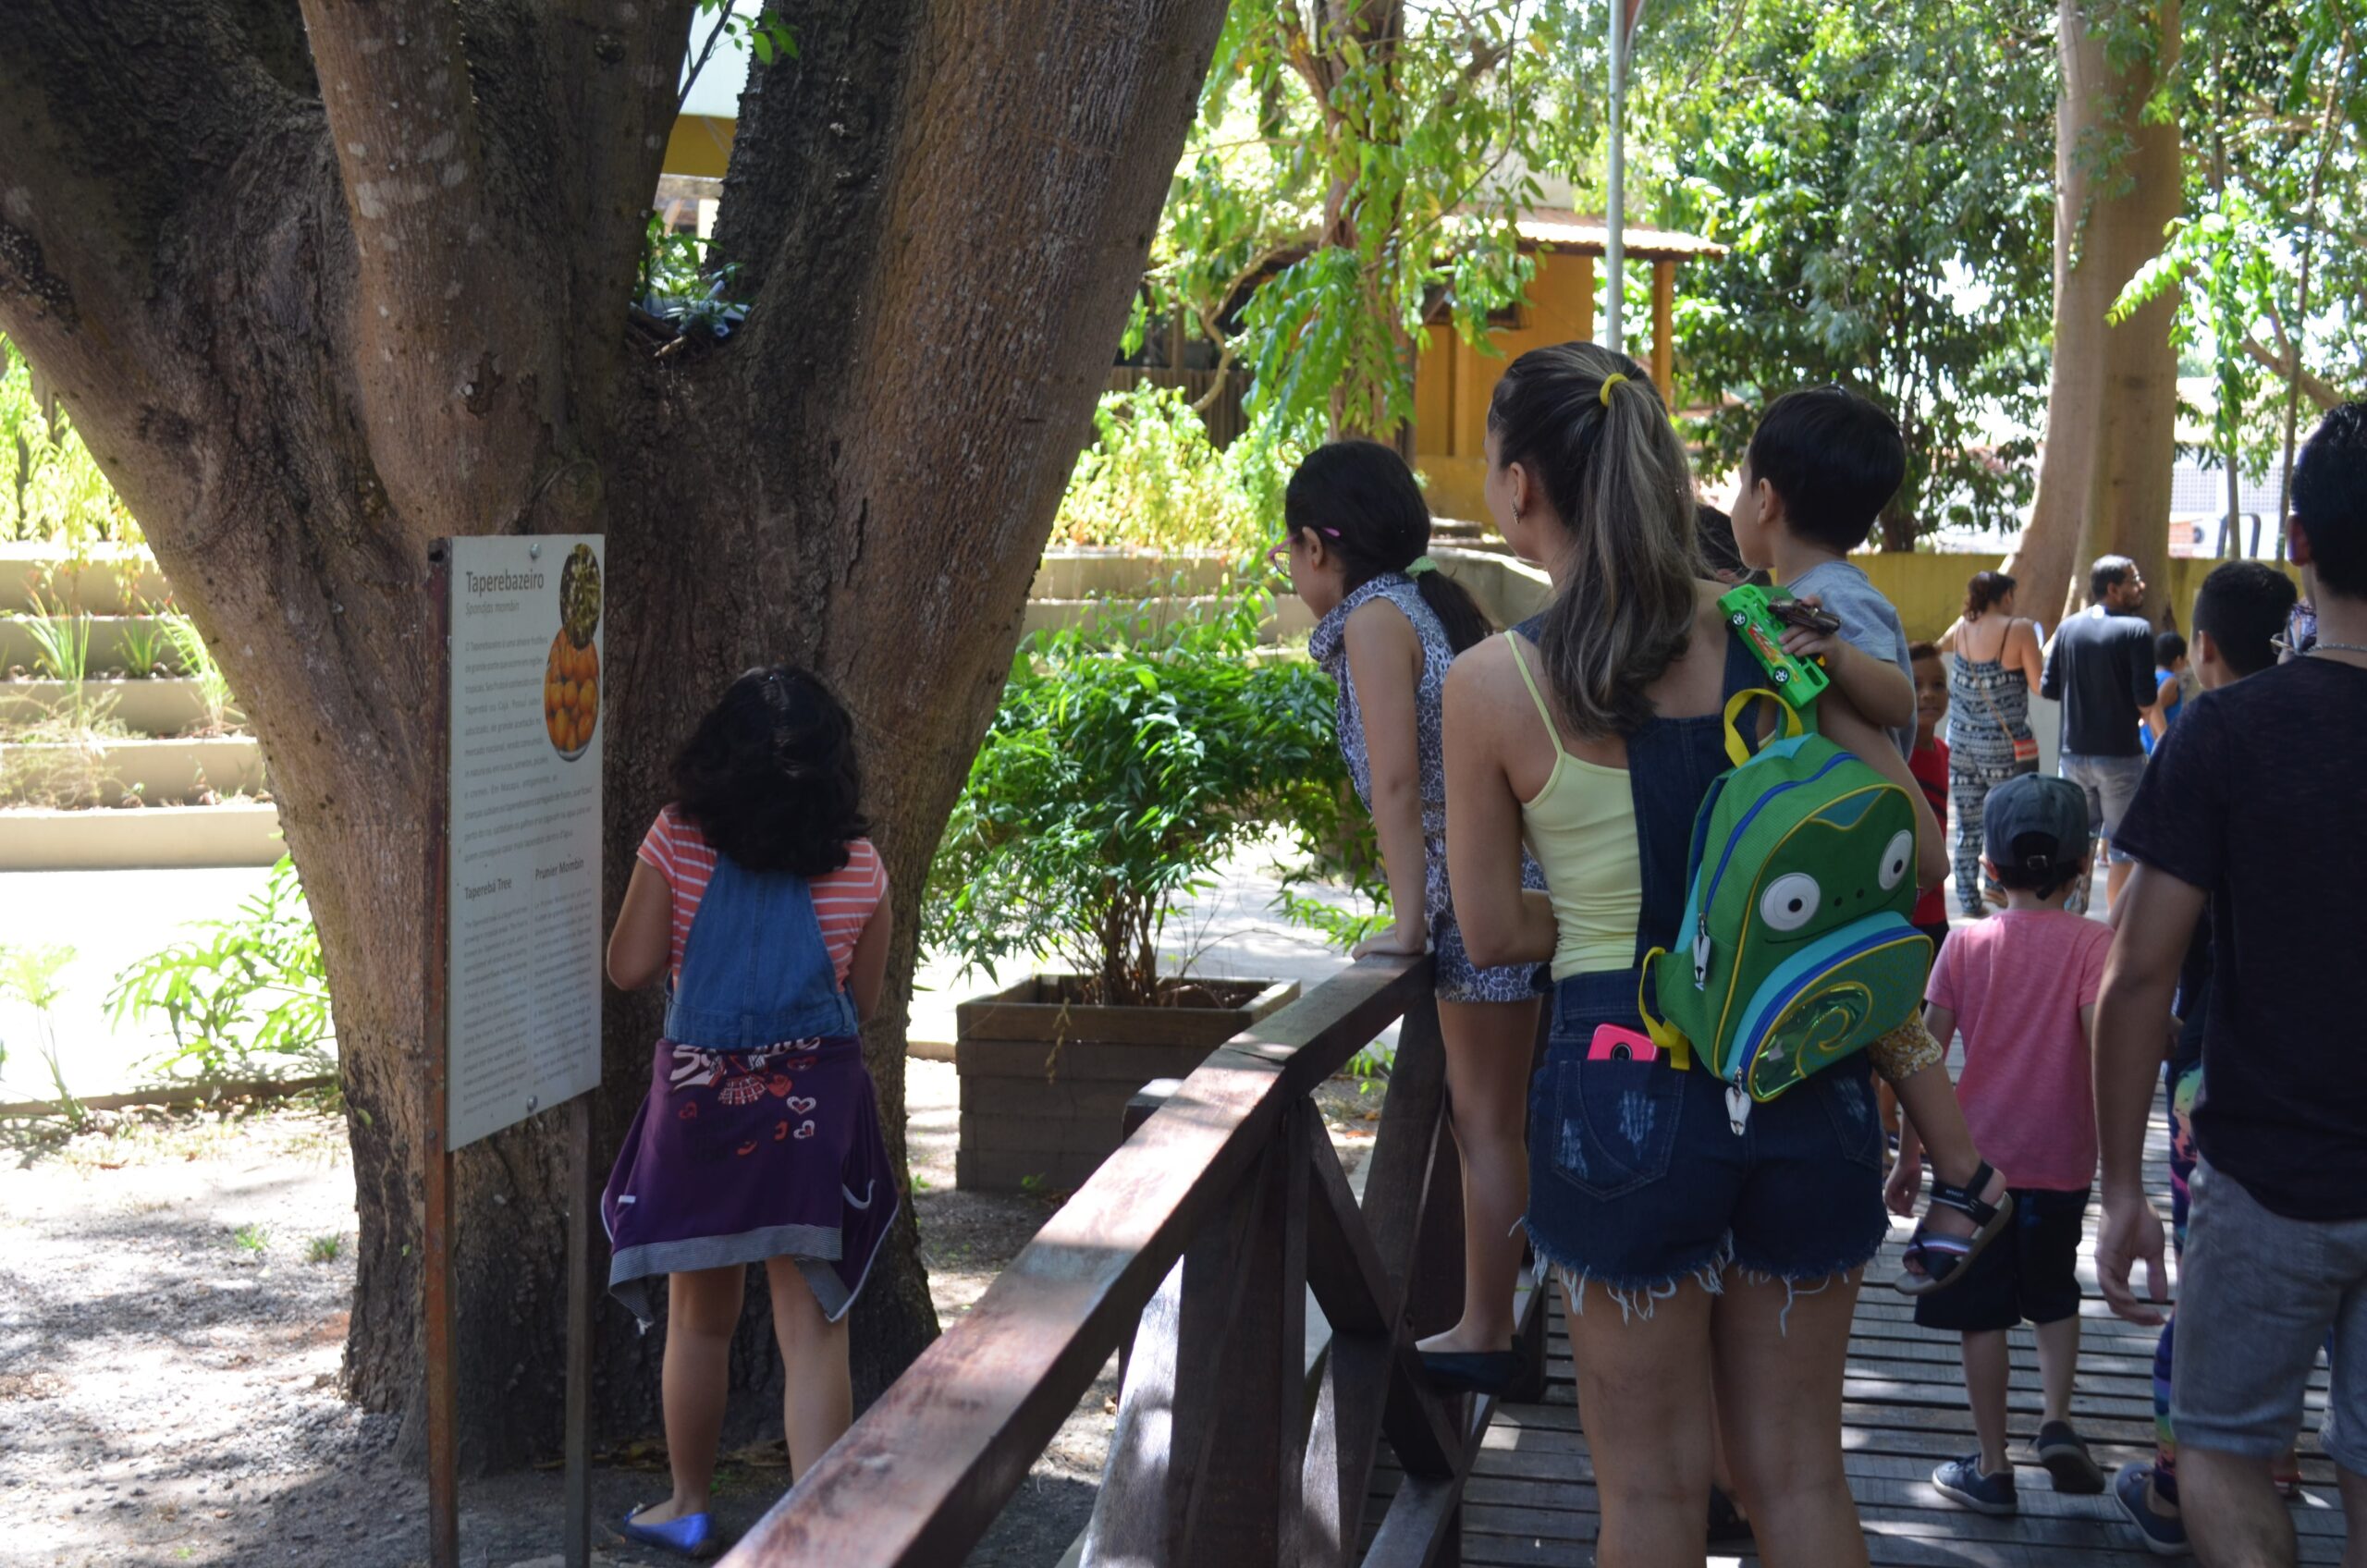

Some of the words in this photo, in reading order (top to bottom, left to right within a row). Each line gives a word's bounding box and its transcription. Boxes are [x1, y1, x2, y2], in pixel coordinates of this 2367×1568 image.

[466, 569, 544, 597] Taperebazeiro
[535, 865, 558, 880] Prunier
[558, 858, 584, 874] Mombin
[464, 881, 497, 901] Taperebá
[497, 877, 512, 888] Tree
